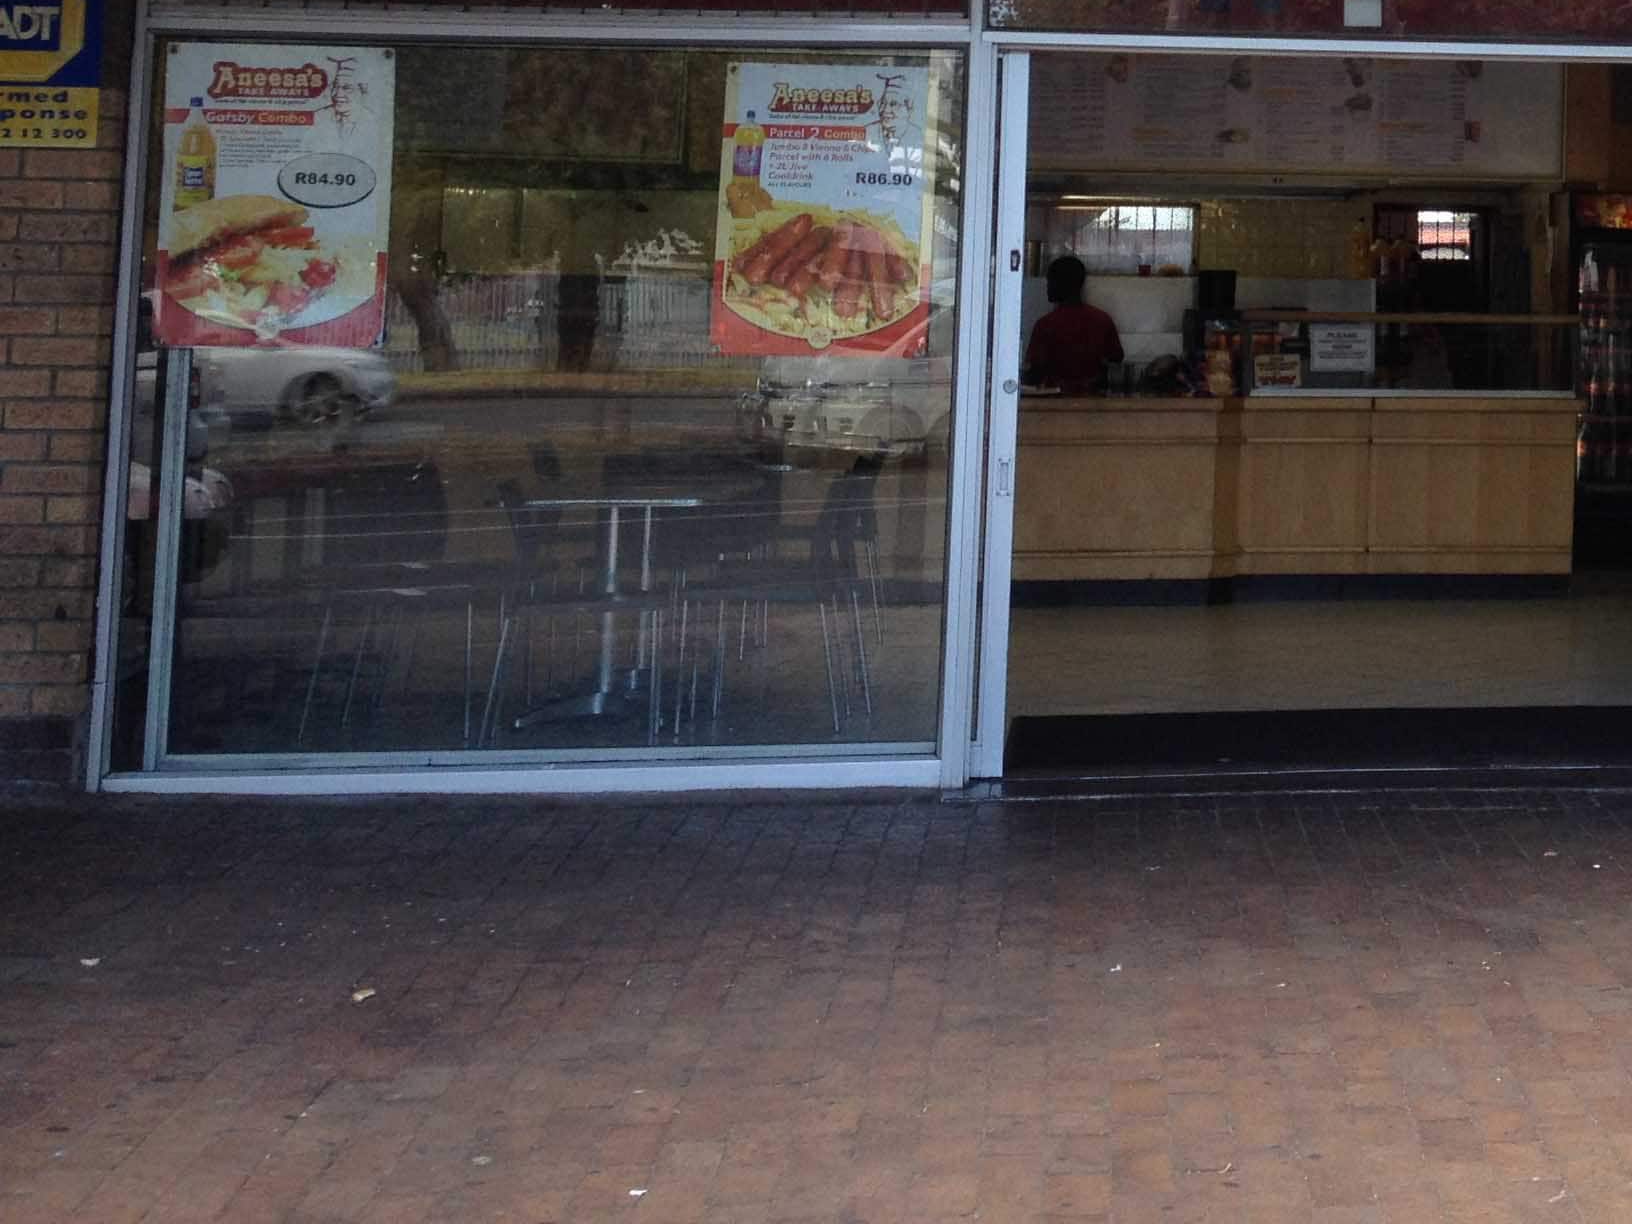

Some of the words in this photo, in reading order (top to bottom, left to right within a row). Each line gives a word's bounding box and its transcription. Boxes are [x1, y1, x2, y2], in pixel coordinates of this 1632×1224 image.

[51, 128, 87, 139] 300
[769, 127, 805, 137] Parcel
[295, 172, 356, 186] R84.90
[855, 172, 912, 186] R86.90
